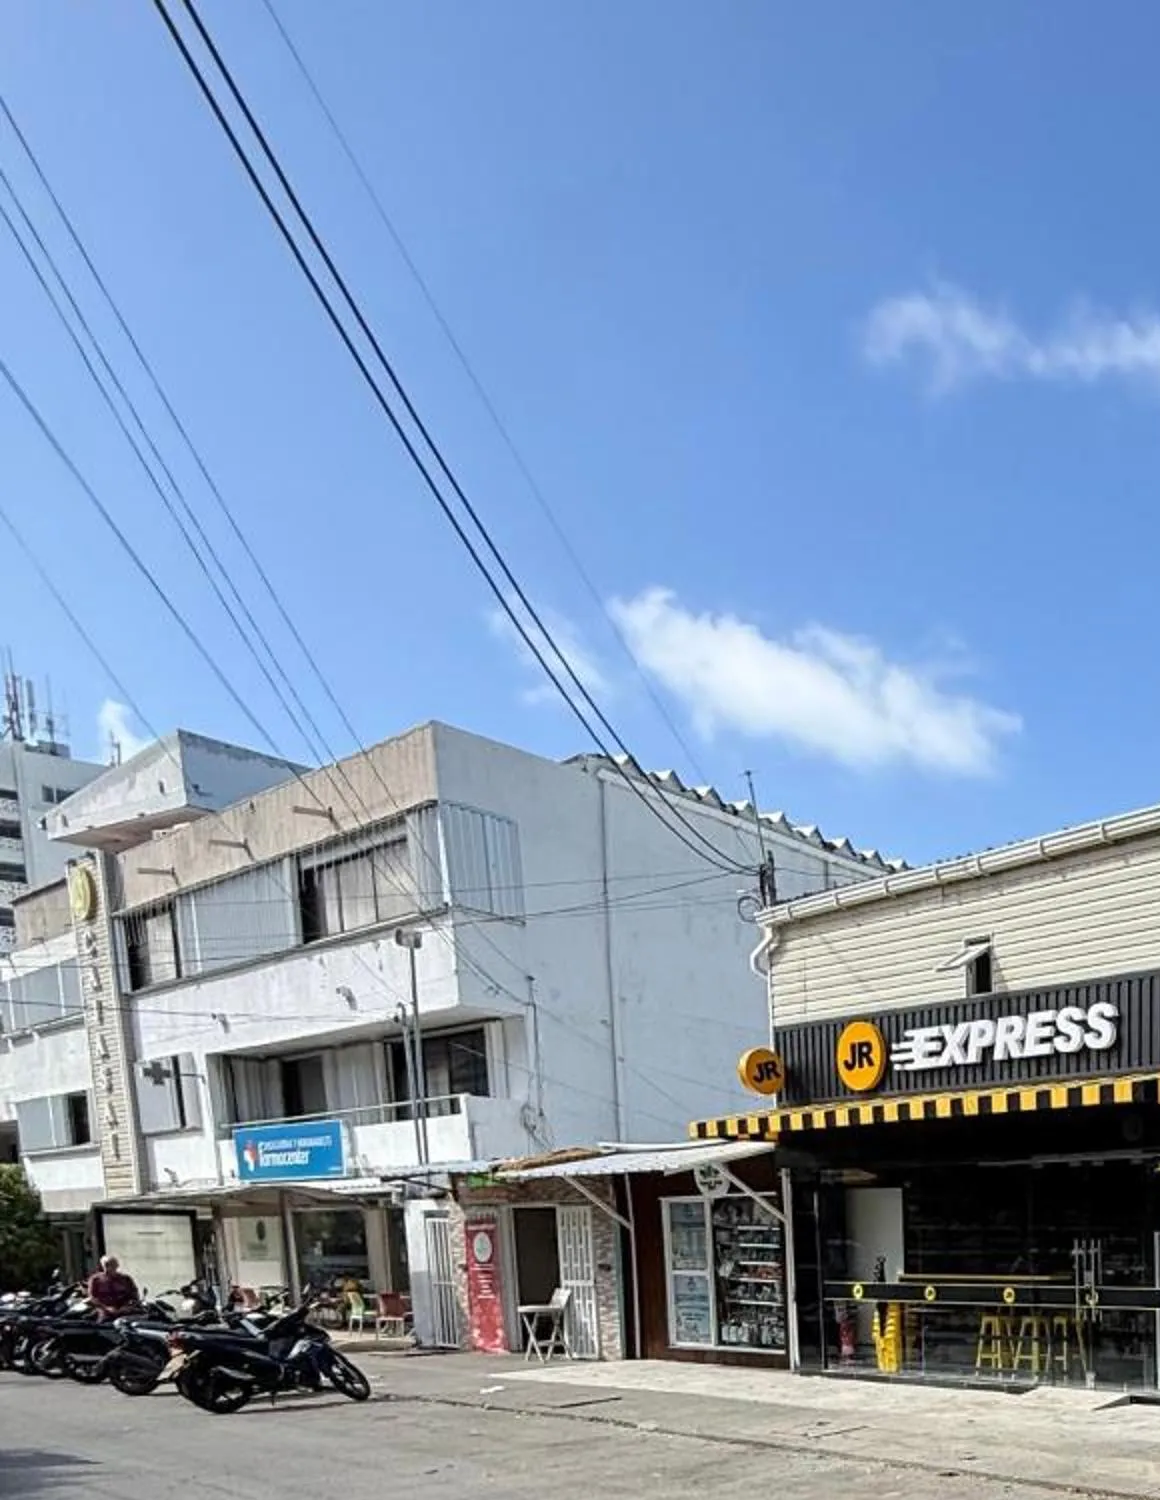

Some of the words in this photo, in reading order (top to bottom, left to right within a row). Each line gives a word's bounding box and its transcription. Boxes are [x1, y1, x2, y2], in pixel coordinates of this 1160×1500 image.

[842, 1040, 875, 1071] JR
[889, 1001, 1119, 1071] EXPRESS
[752, 1060, 781, 1083] JR
